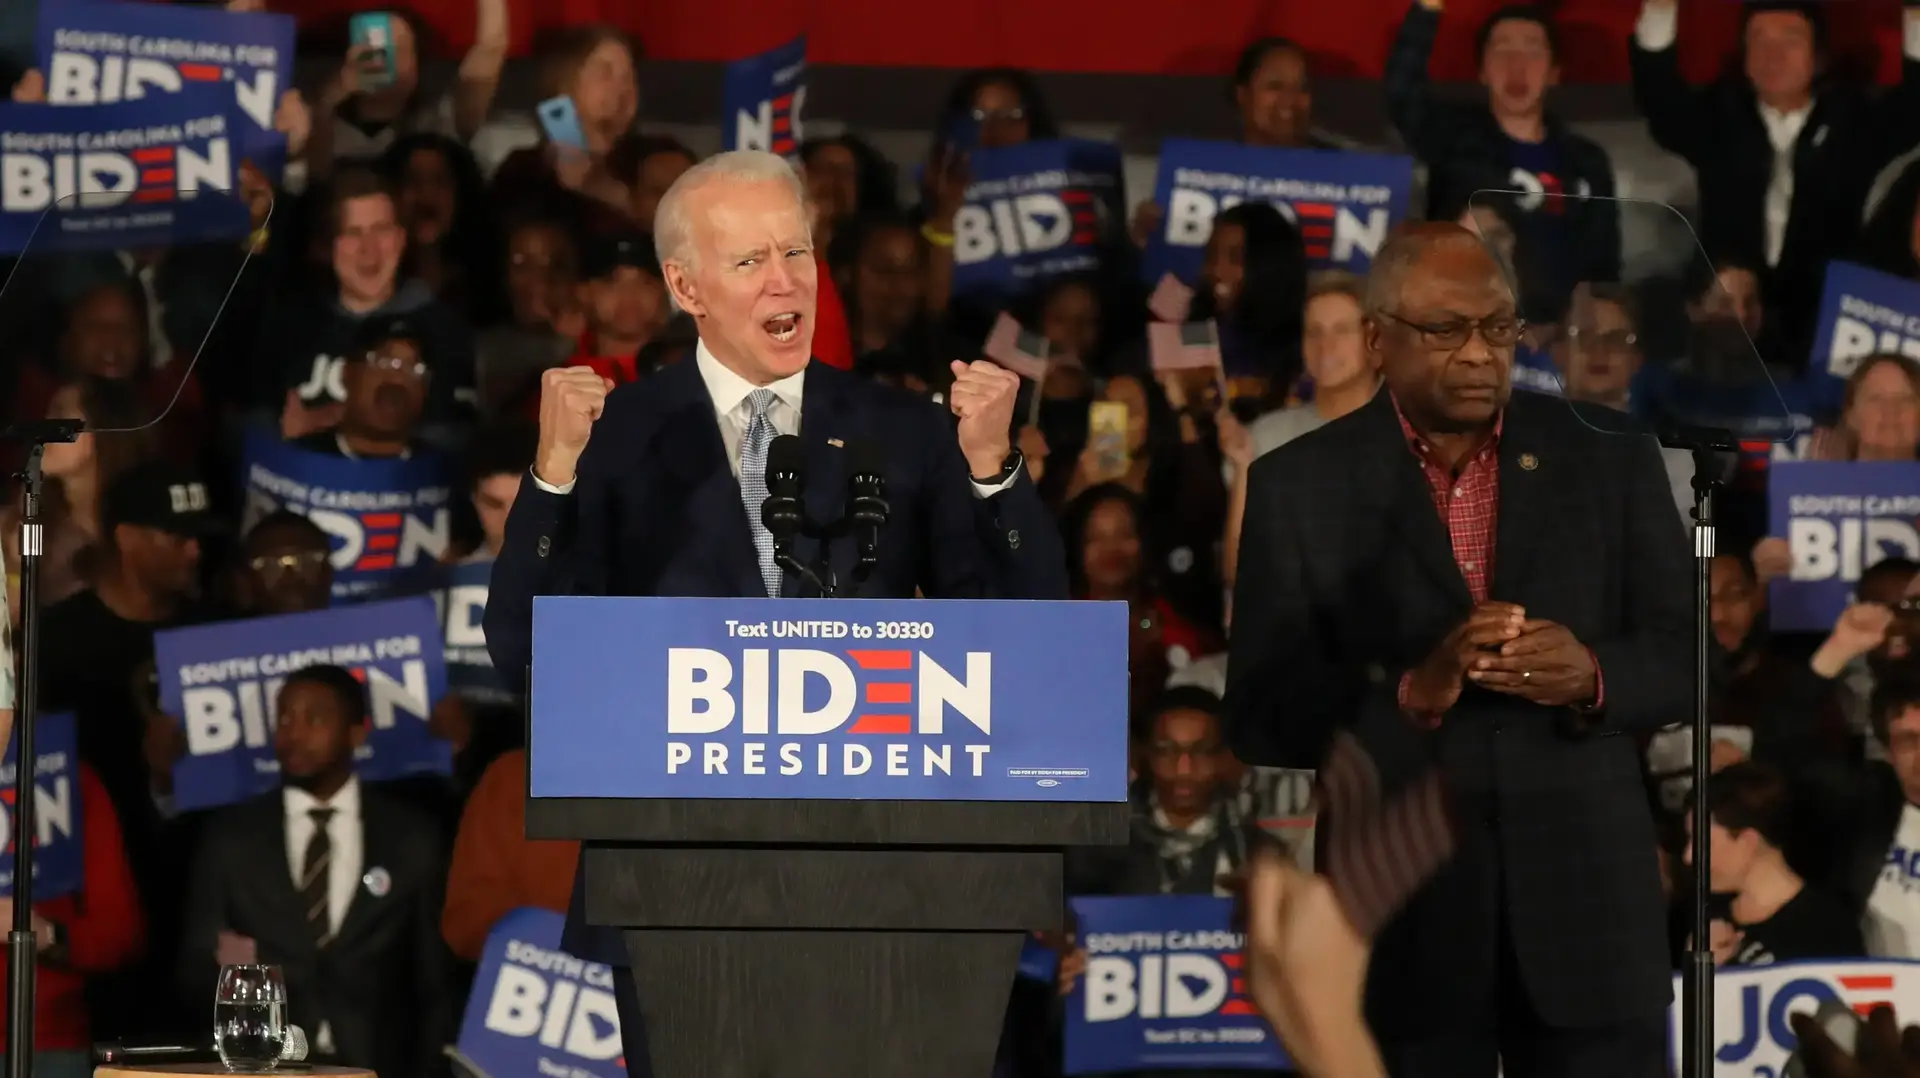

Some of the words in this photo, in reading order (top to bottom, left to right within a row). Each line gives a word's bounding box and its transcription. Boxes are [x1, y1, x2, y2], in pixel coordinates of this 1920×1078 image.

[54, 29, 126, 52] SOUTH
[128, 35, 232, 62] CAROLINA
[77, 126, 182, 149] CAROLINA
[184, 115, 226, 136] FOR
[2, 138, 231, 211] BIDEN
[953, 190, 1110, 265] BIDE
[1165, 187, 1389, 262] BEN
[241, 486, 449, 569] DEN
[1789, 496, 1862, 515] SOUTH
[725, 620, 768, 639] Text
[773, 620, 848, 638] UNITED
[852, 622, 872, 639] to
[876, 622, 934, 640] 30330
[179, 657, 256, 686] SOUTH
[374, 635, 421, 659] FOR
[182, 660, 430, 756] BIN
[667, 648, 992, 735] BIDEN
[667, 742, 991, 777] PRESIDENT
[506, 939, 583, 980] SOUTH
[1085, 932, 1162, 952] SOUTH
[485, 962, 627, 1067] BID
